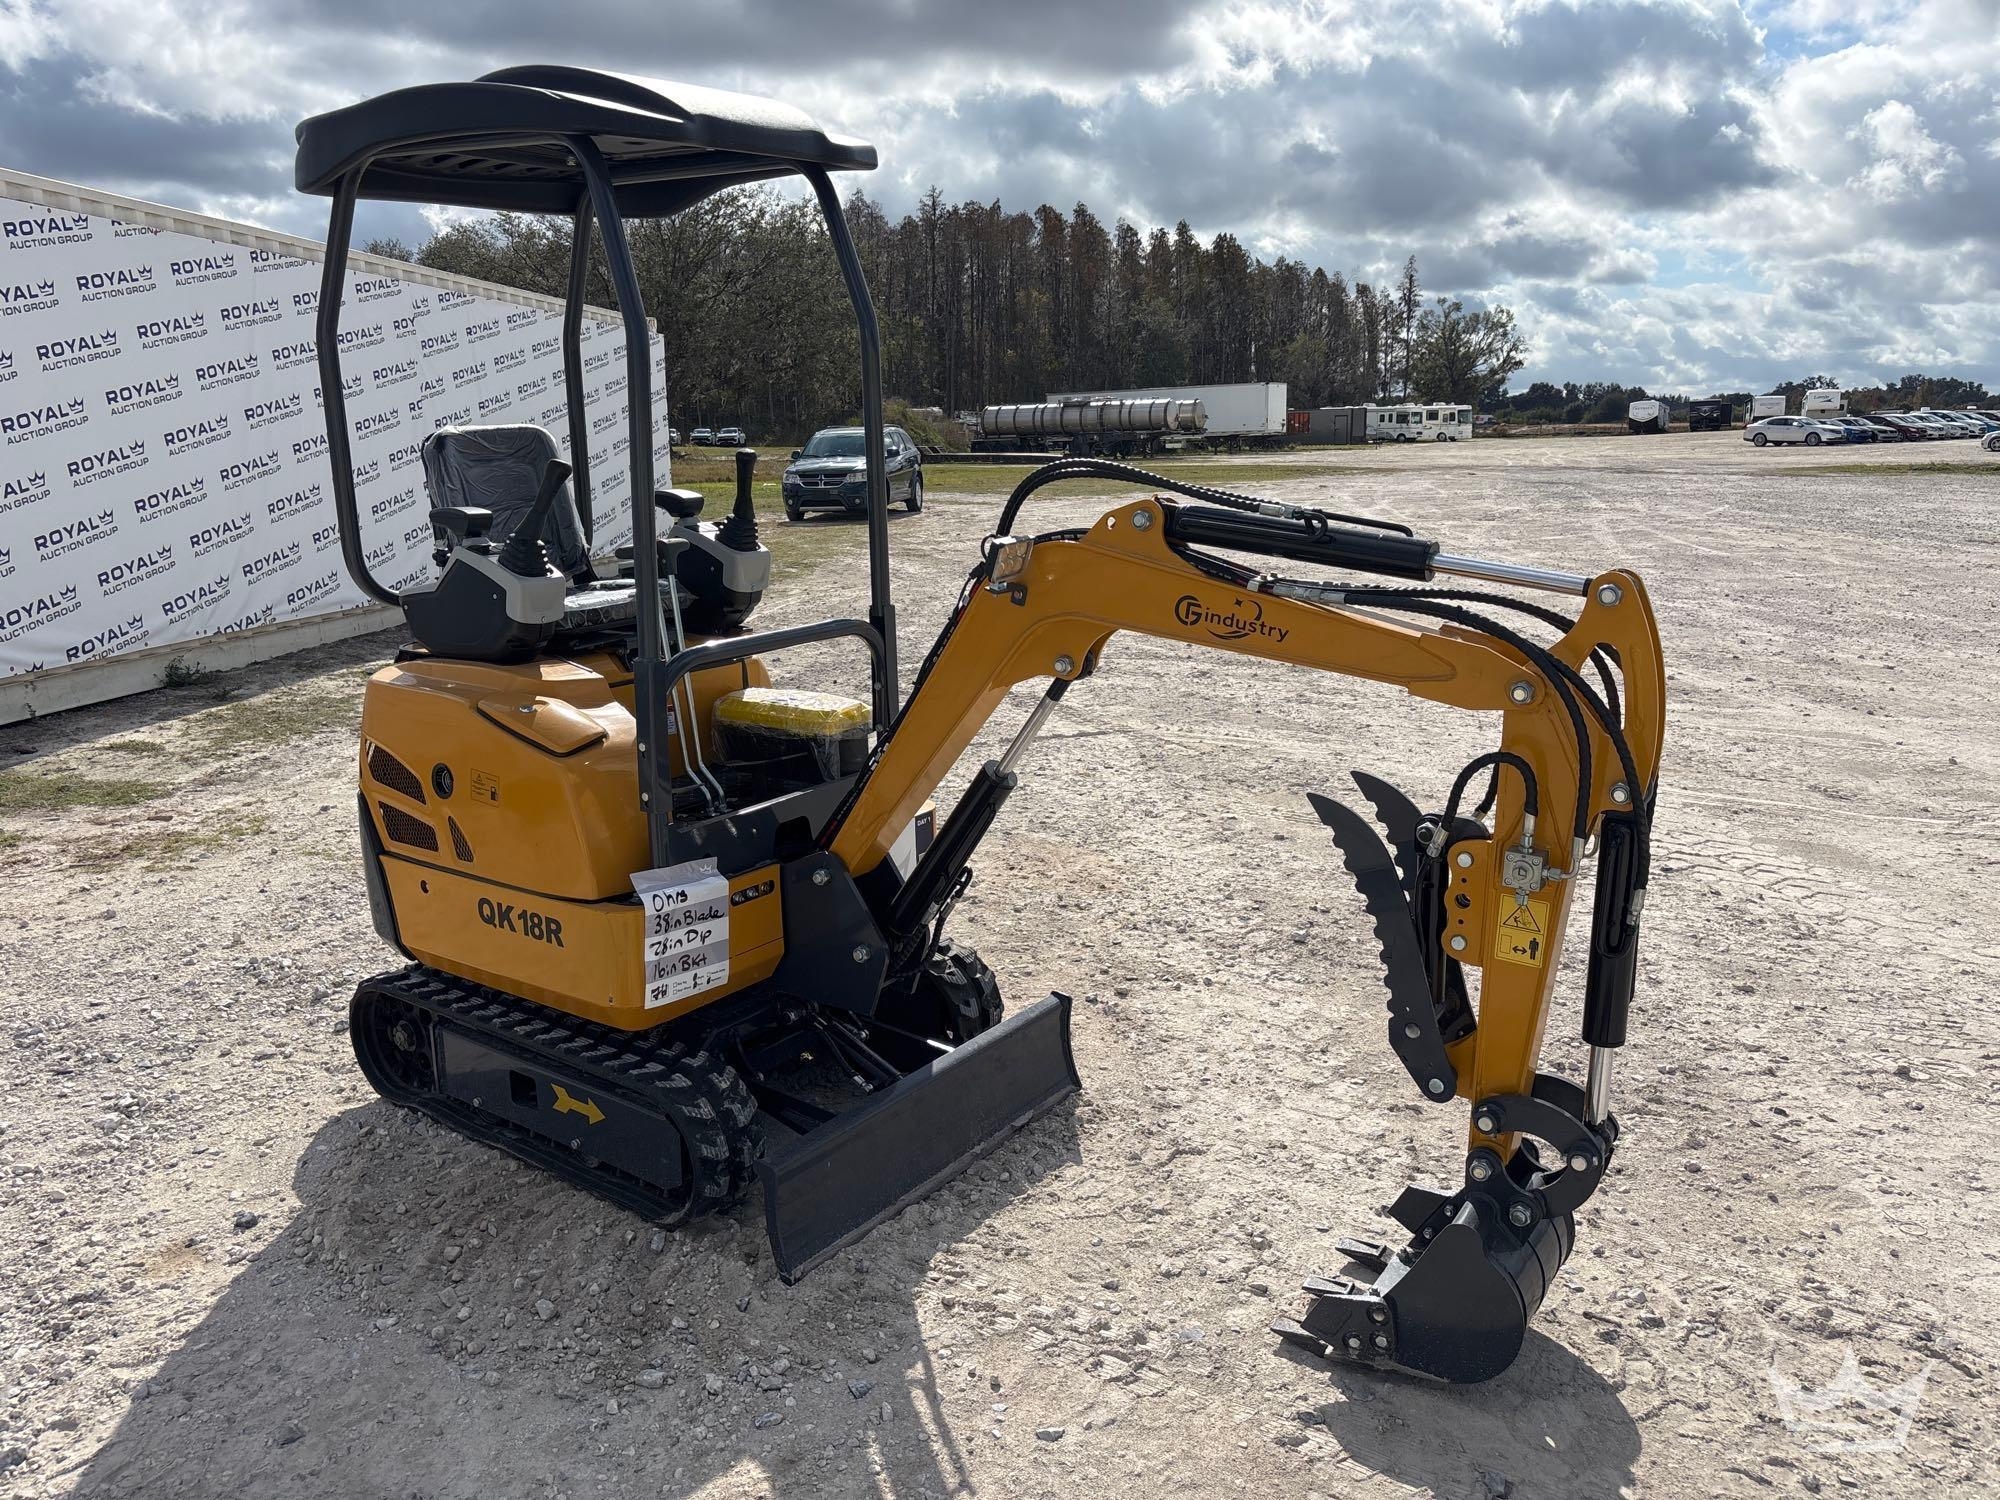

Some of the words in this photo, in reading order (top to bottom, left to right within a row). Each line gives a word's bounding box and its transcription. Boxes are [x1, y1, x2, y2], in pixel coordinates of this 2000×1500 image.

[3, 216, 73, 237] ROYAL
[10, 237, 56, 250] AUCTION
[58, 233, 93, 244] GROUP
[171, 257, 222, 275] ROYAL
[254, 263, 283, 273] AUCTION
[76, 269, 139, 290] ROYAL
[176, 274, 210, 286] AUCTION
[211, 270, 237, 281] GROUP
[355, 278, 391, 294] ROYAL
[0, 284, 39, 303] YAL
[82, 289, 124, 302] AUCTION
[126, 283, 156, 295] GROUP
[293, 291, 318, 306] ROY
[23, 299, 59, 313] GROUP
[221, 301, 268, 321] ROYAL
[296, 307, 319, 316] AUCTIO
[137, 316, 192, 339] ROYAL
[225, 318, 258, 331] AUCTION
[259, 313, 282, 324] GROUP
[393, 317, 415, 331] ROY
[507, 311, 530, 324] ROYAL
[142, 334, 179, 350] AUCTION
[180, 329, 207, 342] GROUP
[338, 327, 374, 345] ROYAL
[396, 330, 416, 339] AUCTIO
[466, 322, 492, 337] ROYAL
[36, 335, 102, 360] ROYAL
[272, 341, 314, 361] ROYAL
[341, 344, 365, 354] AUCTION
[366, 337, 385, 348] GROUP
[421, 334, 450, 350] ROYAL
[532, 339, 554, 353] ROYAL
[42, 356, 86, 372] AUCTION
[88, 348, 121, 361] GROUP
[276, 357, 304, 371] AUCTION
[306, 355, 318, 364] GRO
[494, 351, 518, 366] ROYAL
[196, 359, 245, 381] ROYAL
[373, 363, 407, 381] ROYAL
[453, 365, 480, 381] ROYAL
[200, 377, 234, 392] AUCTION
[235, 370, 260, 382] GROUP
[518, 381, 541, 395] ROYAL
[105, 379, 166, 405] ROYAL
[344, 388, 364, 399] GROUP
[478, 394, 504, 411] ROYAL
[111, 400, 152, 416] AUCTION
[154, 391, 183, 405] GROUP
[244, 398, 289, 421] ROYAL
[542, 405, 563, 420] ROYAL
[1, 404, 69, 434] ROYAL
[250, 415, 279, 430] AUCTION
[280, 408, 303, 420] GROUP
[355, 412, 390, 432] ROYAL
[7, 426, 53, 445] AUCTION
[55, 416, 89, 432] GROUP
[164, 421, 216, 446] ROYAL
[169, 438, 204, 456] AUCTION
[206, 431, 231, 444] GROUP
[292, 435, 327, 455] ROYA
[67, 447, 130, 477] ROYAL
[296, 450, 324, 464] AUCTION
[73, 468, 115, 488] AUCTION
[116, 457, 149, 473] GROUP
[220, 456, 268, 482] ROYAL
[224, 474, 256, 491] AUCTION
[257, 465, 281, 479] GROUP
[14, 489, 50, 508] GROUP
[134, 484, 191, 514] ROYAL
[140, 504, 178, 524] AUCTION
[180, 493, 207, 509] GROUP
[268, 489, 309, 516] ROYAL
[372, 493, 405, 516] ROYAL
[270, 507, 300, 524] AUCTION
[301, 498, 323, 511] GROUP
[34, 517, 99, 551] ROYAL
[190, 519, 242, 548] ROYAL
[194, 538, 229, 558] AUCTION
[230, 527, 254, 542] GROUP
[312, 524, 339, 544] ROY
[404, 523, 431, 543] ROYA
[40, 541, 84, 563] AUCTION
[86, 526, 118, 544] GROUP
[365, 547, 386, 563] YAL
[98, 553, 158, 586] ROYAL
[242, 549, 289, 577] ROYAL
[248, 567, 278, 586] AUCTION
[279, 555, 302, 570] GROUP
[103, 574, 143, 597] AUCTION
[146, 560, 176, 579] GROUP
[162, 583, 217, 616] ROYAL
[287, 577, 329, 605] ROYAL
[290, 594, 320, 614] AUCTION
[320, 583, 341, 598] GROUP
[46, 601, 82, 623] GROUP
[169, 604, 203, 625] AUCTION
[206, 589, 230, 608] GROUP
[66, 624, 129, 662] ROYAL
[116, 630, 149, 650] GROUP
[478, 897, 564, 948] QK18R
[683, 905, 725, 926] Blade
